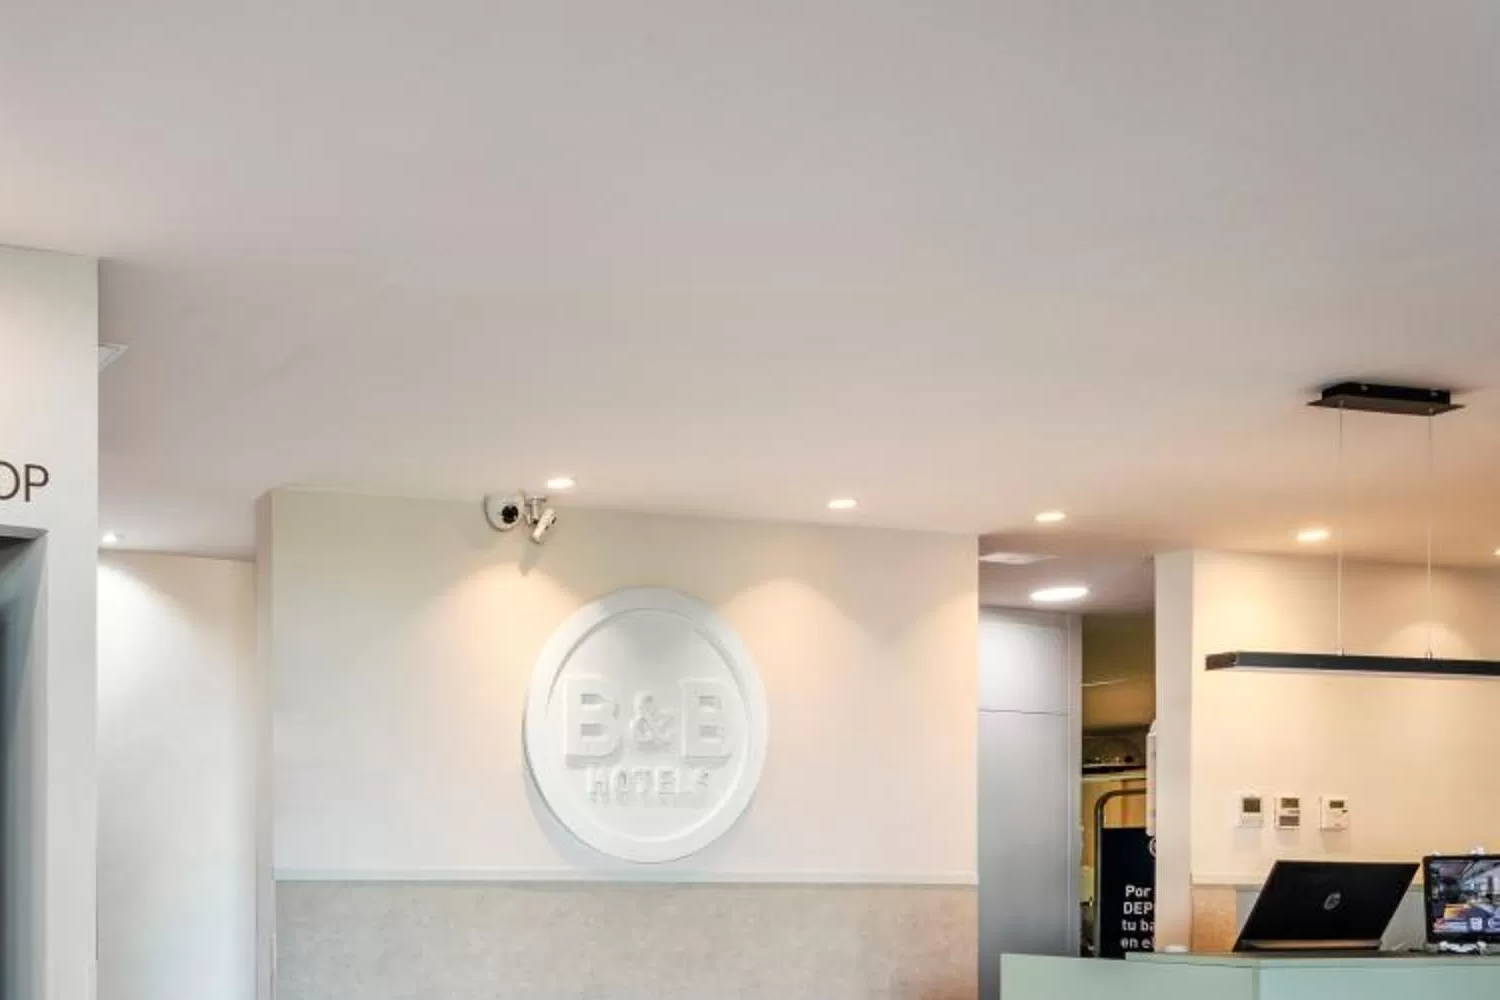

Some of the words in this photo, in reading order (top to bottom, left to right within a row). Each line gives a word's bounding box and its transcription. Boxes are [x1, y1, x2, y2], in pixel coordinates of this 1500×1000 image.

[563, 677, 732, 760] B&B
[586, 766, 711, 796] HOTELS
[1125, 884, 1152, 897] Por
[1122, 919, 1137, 931] tu
[1120, 937, 1139, 949] en
